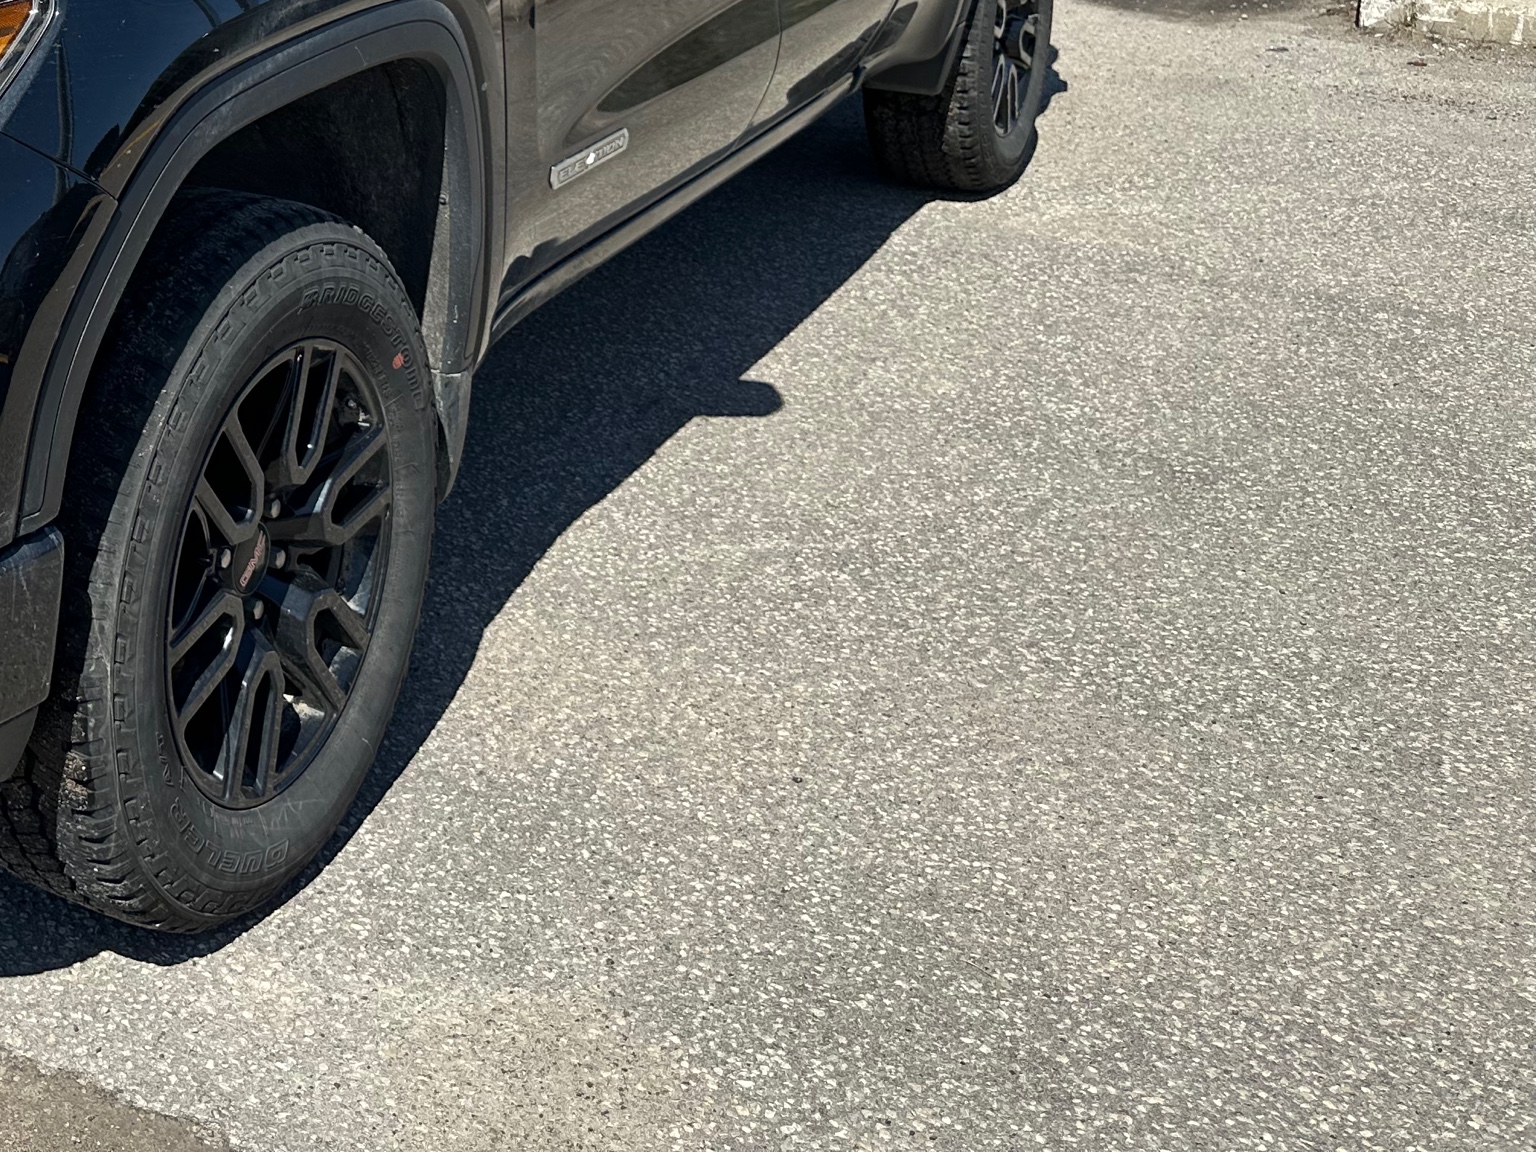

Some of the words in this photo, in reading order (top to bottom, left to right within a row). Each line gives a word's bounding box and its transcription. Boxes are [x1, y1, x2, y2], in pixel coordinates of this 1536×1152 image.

[559, 136, 625, 181] ELETION
[300, 282, 426, 411] BRIDGESTONE
[170, 797, 289, 874] DUELER
